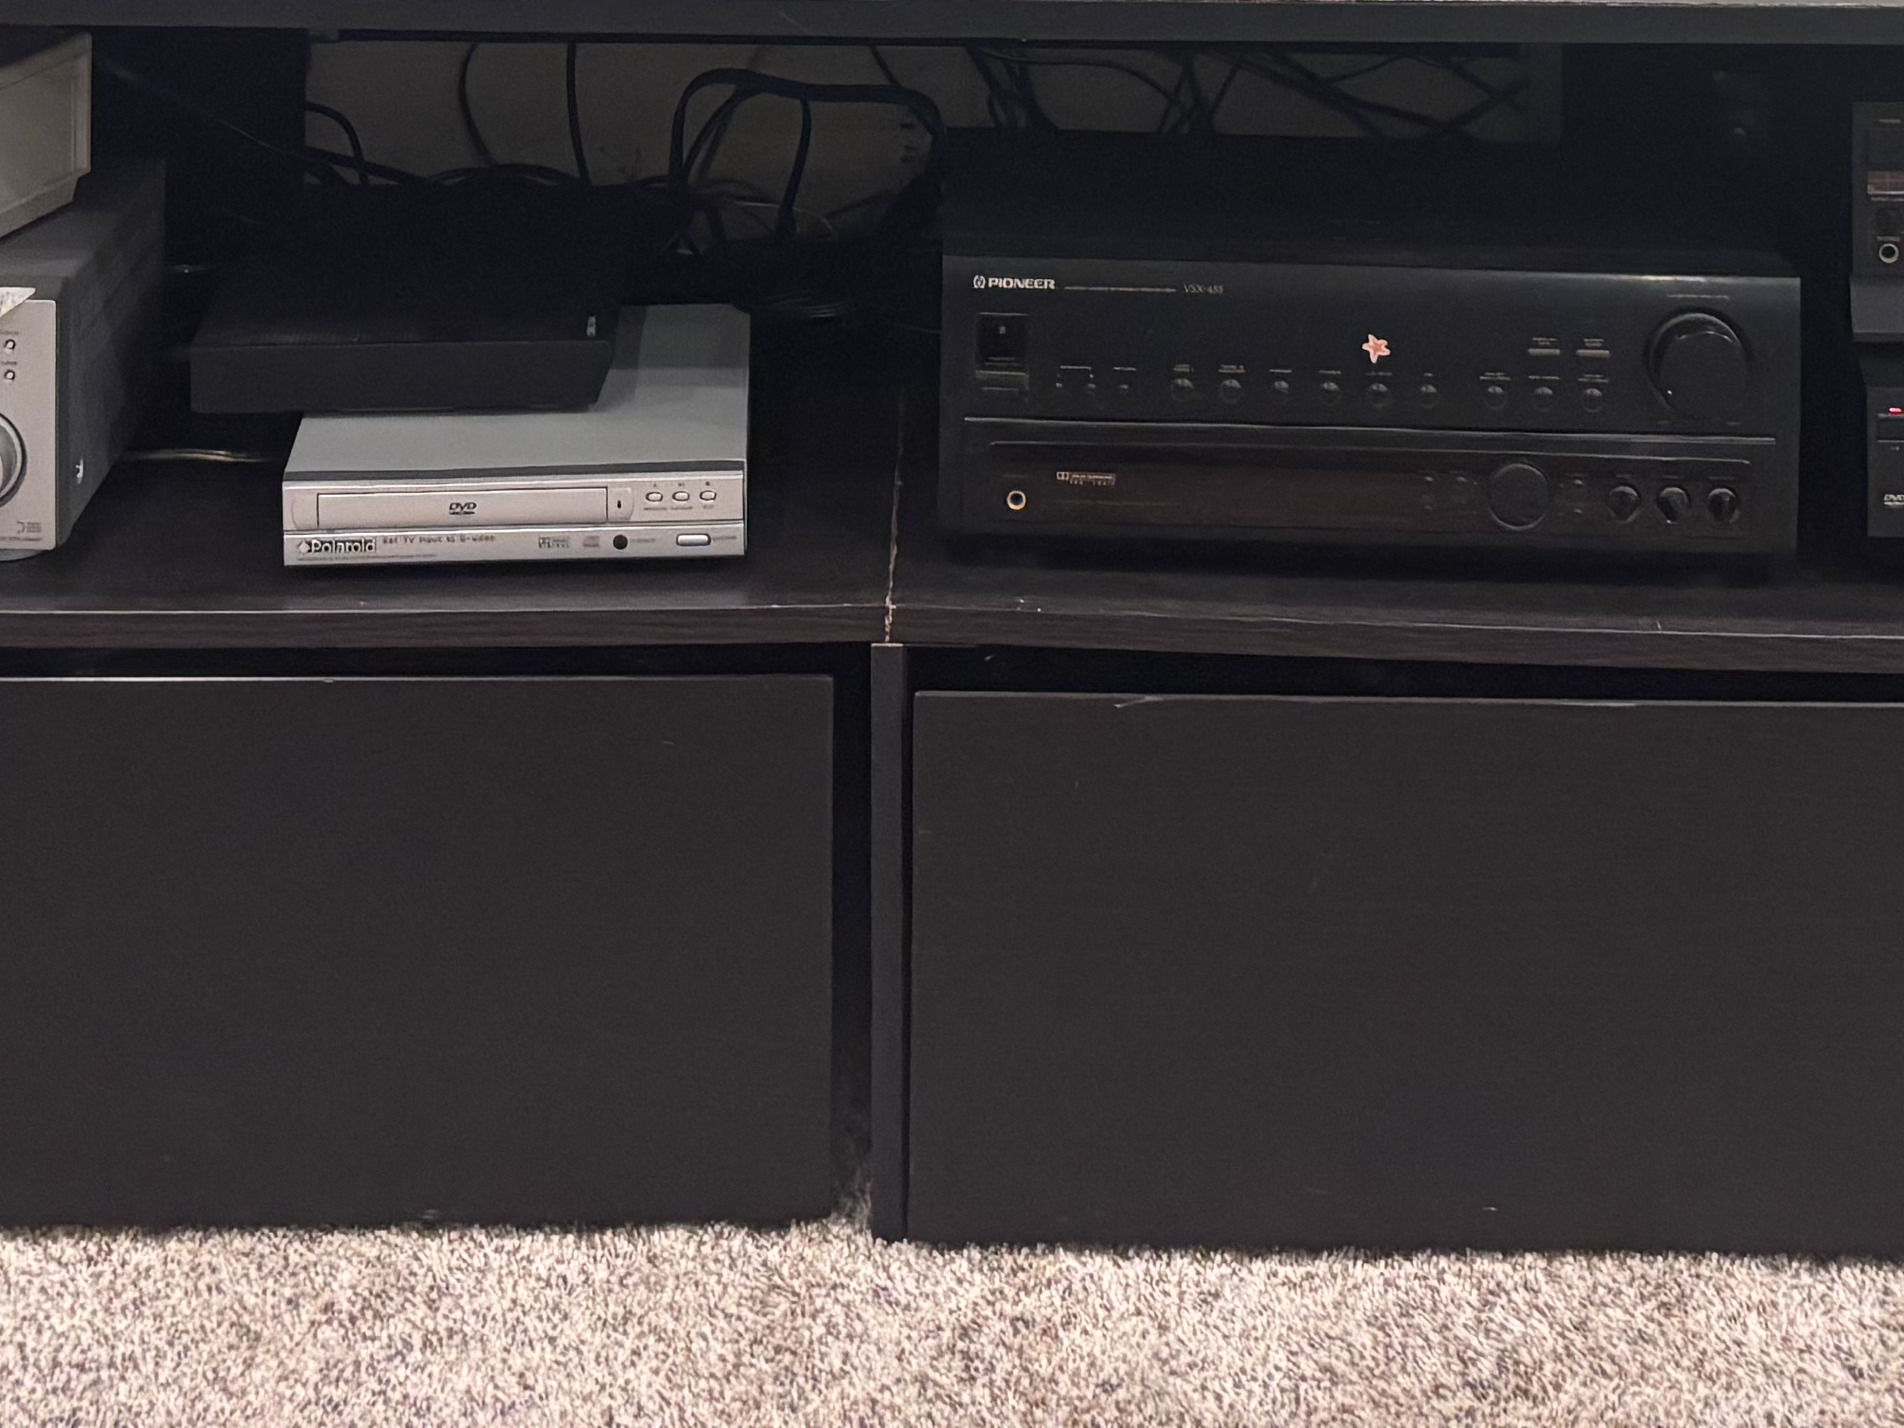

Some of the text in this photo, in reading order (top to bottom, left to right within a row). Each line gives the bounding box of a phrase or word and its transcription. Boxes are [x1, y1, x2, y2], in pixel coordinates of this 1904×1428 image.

[988, 278, 1055, 289] PIONEER
[449, 502, 477, 515] DVD
[312, 539, 376, 553] Polaroid
